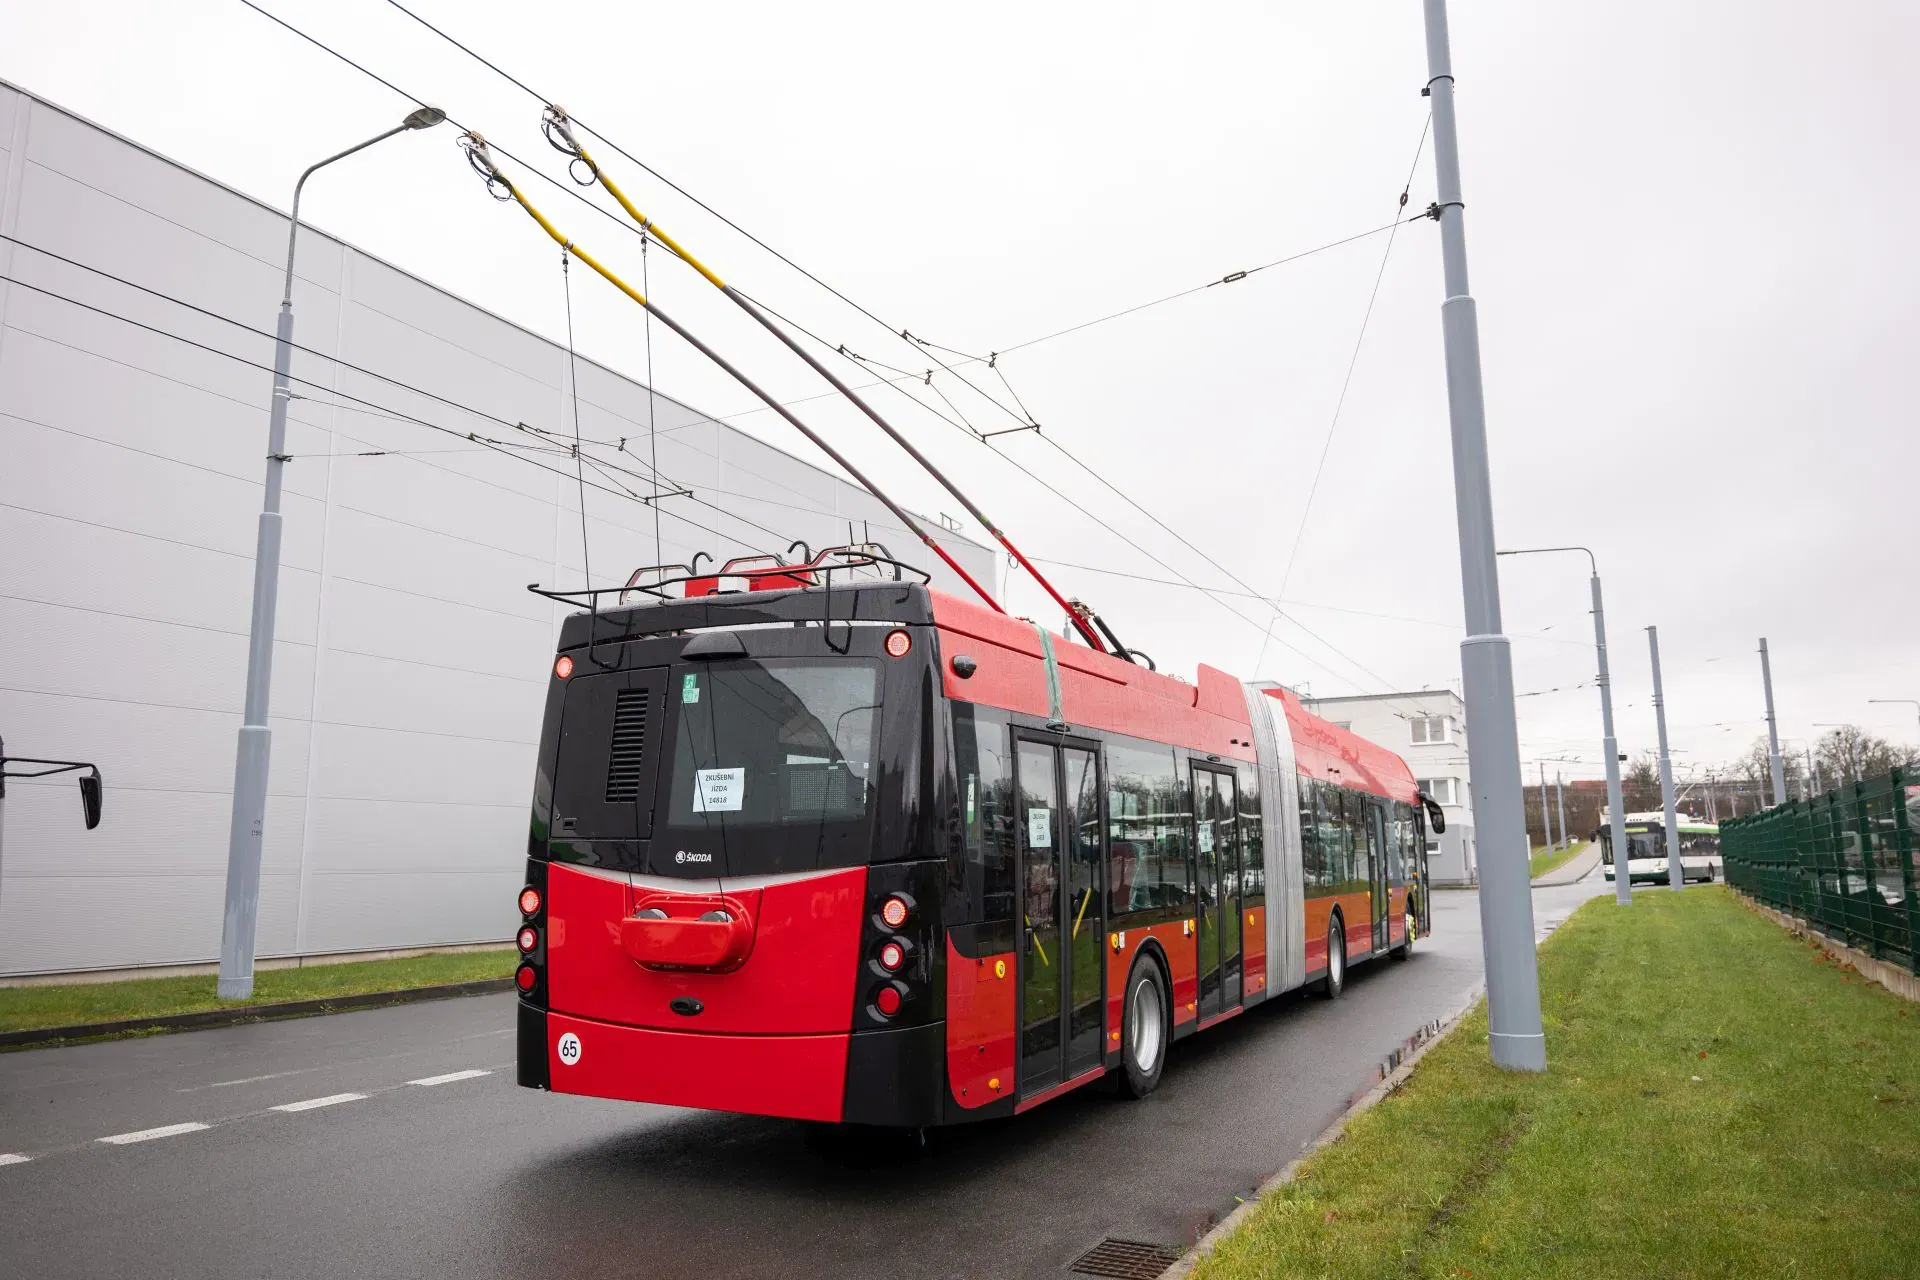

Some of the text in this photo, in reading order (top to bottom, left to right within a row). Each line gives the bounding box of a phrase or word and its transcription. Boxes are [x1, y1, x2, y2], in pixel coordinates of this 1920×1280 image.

[705, 773, 734, 781] ZKUŠEBNÍ
[711, 784, 728, 792] JÍZDA
[686, 851, 712, 862] ŠKODA
[562, 1040, 577, 1057] 65
